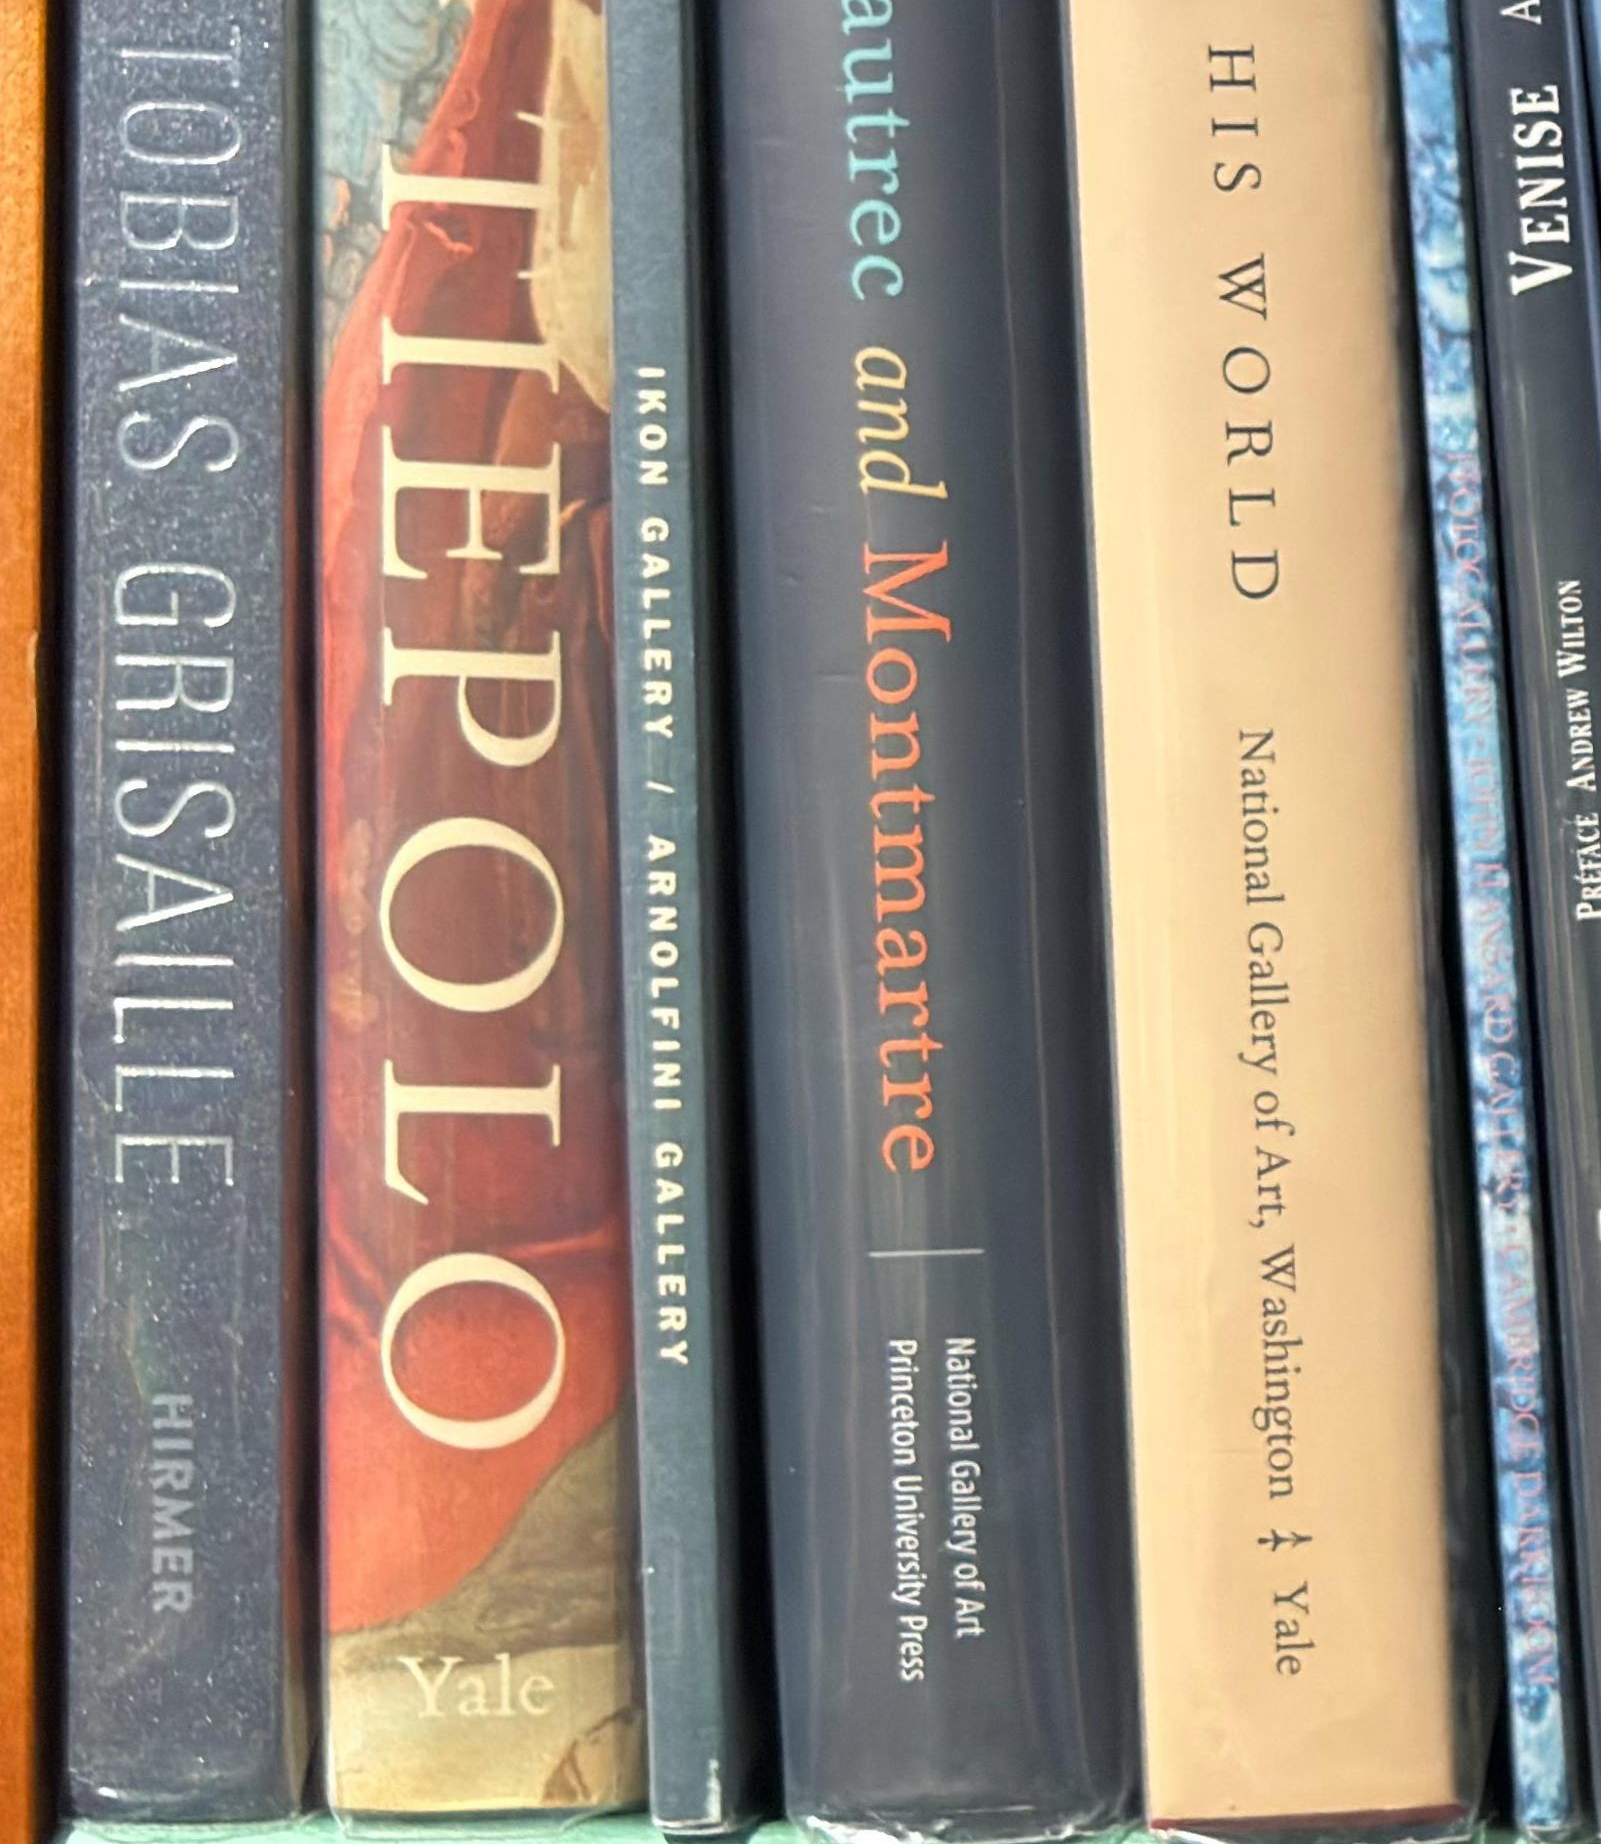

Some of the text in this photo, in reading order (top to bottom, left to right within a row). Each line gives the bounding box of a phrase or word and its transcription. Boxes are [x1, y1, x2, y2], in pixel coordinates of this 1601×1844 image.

[116, 23, 241, 474] TOBIAS
[1208, 44, 1262, 193] HIS
[1511, 85, 1572, 296] VENISE
[852, 342, 949, 503] and
[1218, 252, 1282, 602] WORLD
[380, 111, 565, 1451] TIEPOLO
[1556, 580, 1586, 678] WILTON
[1565, 687, 1596, 794] ANDREW
[112, 563, 236, 1186] GRISAILLE
[636, 366, 690, 1367] IKON GALLERY ARNOLFINI GALLERY
[863, 540, 953, 1174] Montmartre
[1236, 728, 1316, 1677] National Gallery of Art, Washington Yale
[151, 1393, 192, 1614] HIRMER
[890, 1338, 926, 1682] Princeton University Press
[944, 1338, 984, 1638] National Gallery Art
[399, 1653, 556, 1718] Yale
